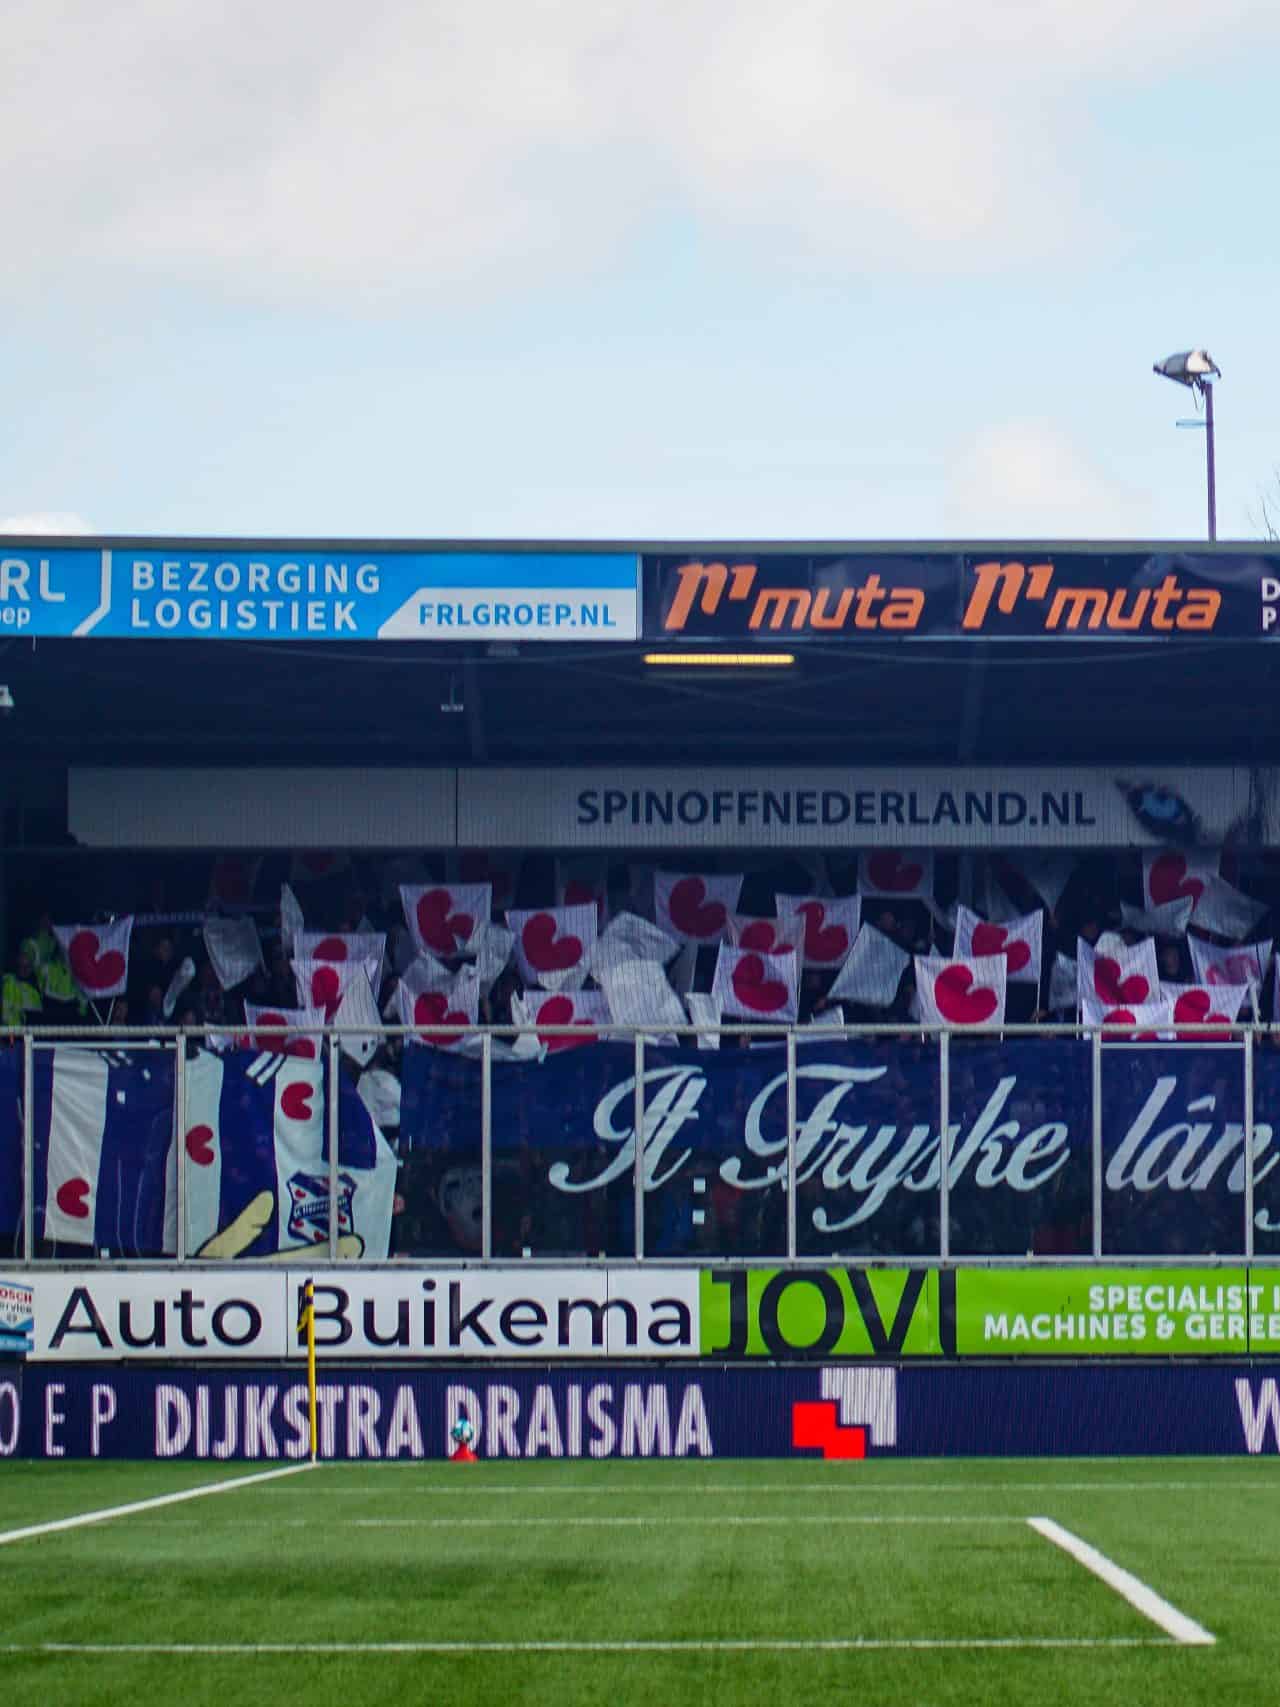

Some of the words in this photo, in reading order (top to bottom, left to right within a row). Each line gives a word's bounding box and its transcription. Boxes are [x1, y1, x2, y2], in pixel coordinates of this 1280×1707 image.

[0, 559, 66, 602] RL
[132, 561, 380, 593] BEZORGING
[0, 607, 30, 630] ep
[132, 598, 358, 631] LOGISTIEK
[418, 602, 617, 627] FRLGROEP.NL
[747, 574, 925, 631] muta
[1043, 575, 1222, 631] muta
[576, 789, 1096, 826] SPINOFFNEDERLAND.NL
[719, 1063, 1072, 1233] Fryske
[1105, 1075, 1280, 1193] lân
[48, 1285, 263, 1350] Auto
[298, 1278, 693, 1350] Buikema
[1088, 1285, 1264, 1312] SPECIALIST
[983, 1313, 1146, 1340] MACHINES
[1156, 1313, 1176, 1340] &
[155, 1383, 424, 1458] DIJKSTRA
[446, 1383, 714, 1458] DRAISMA
